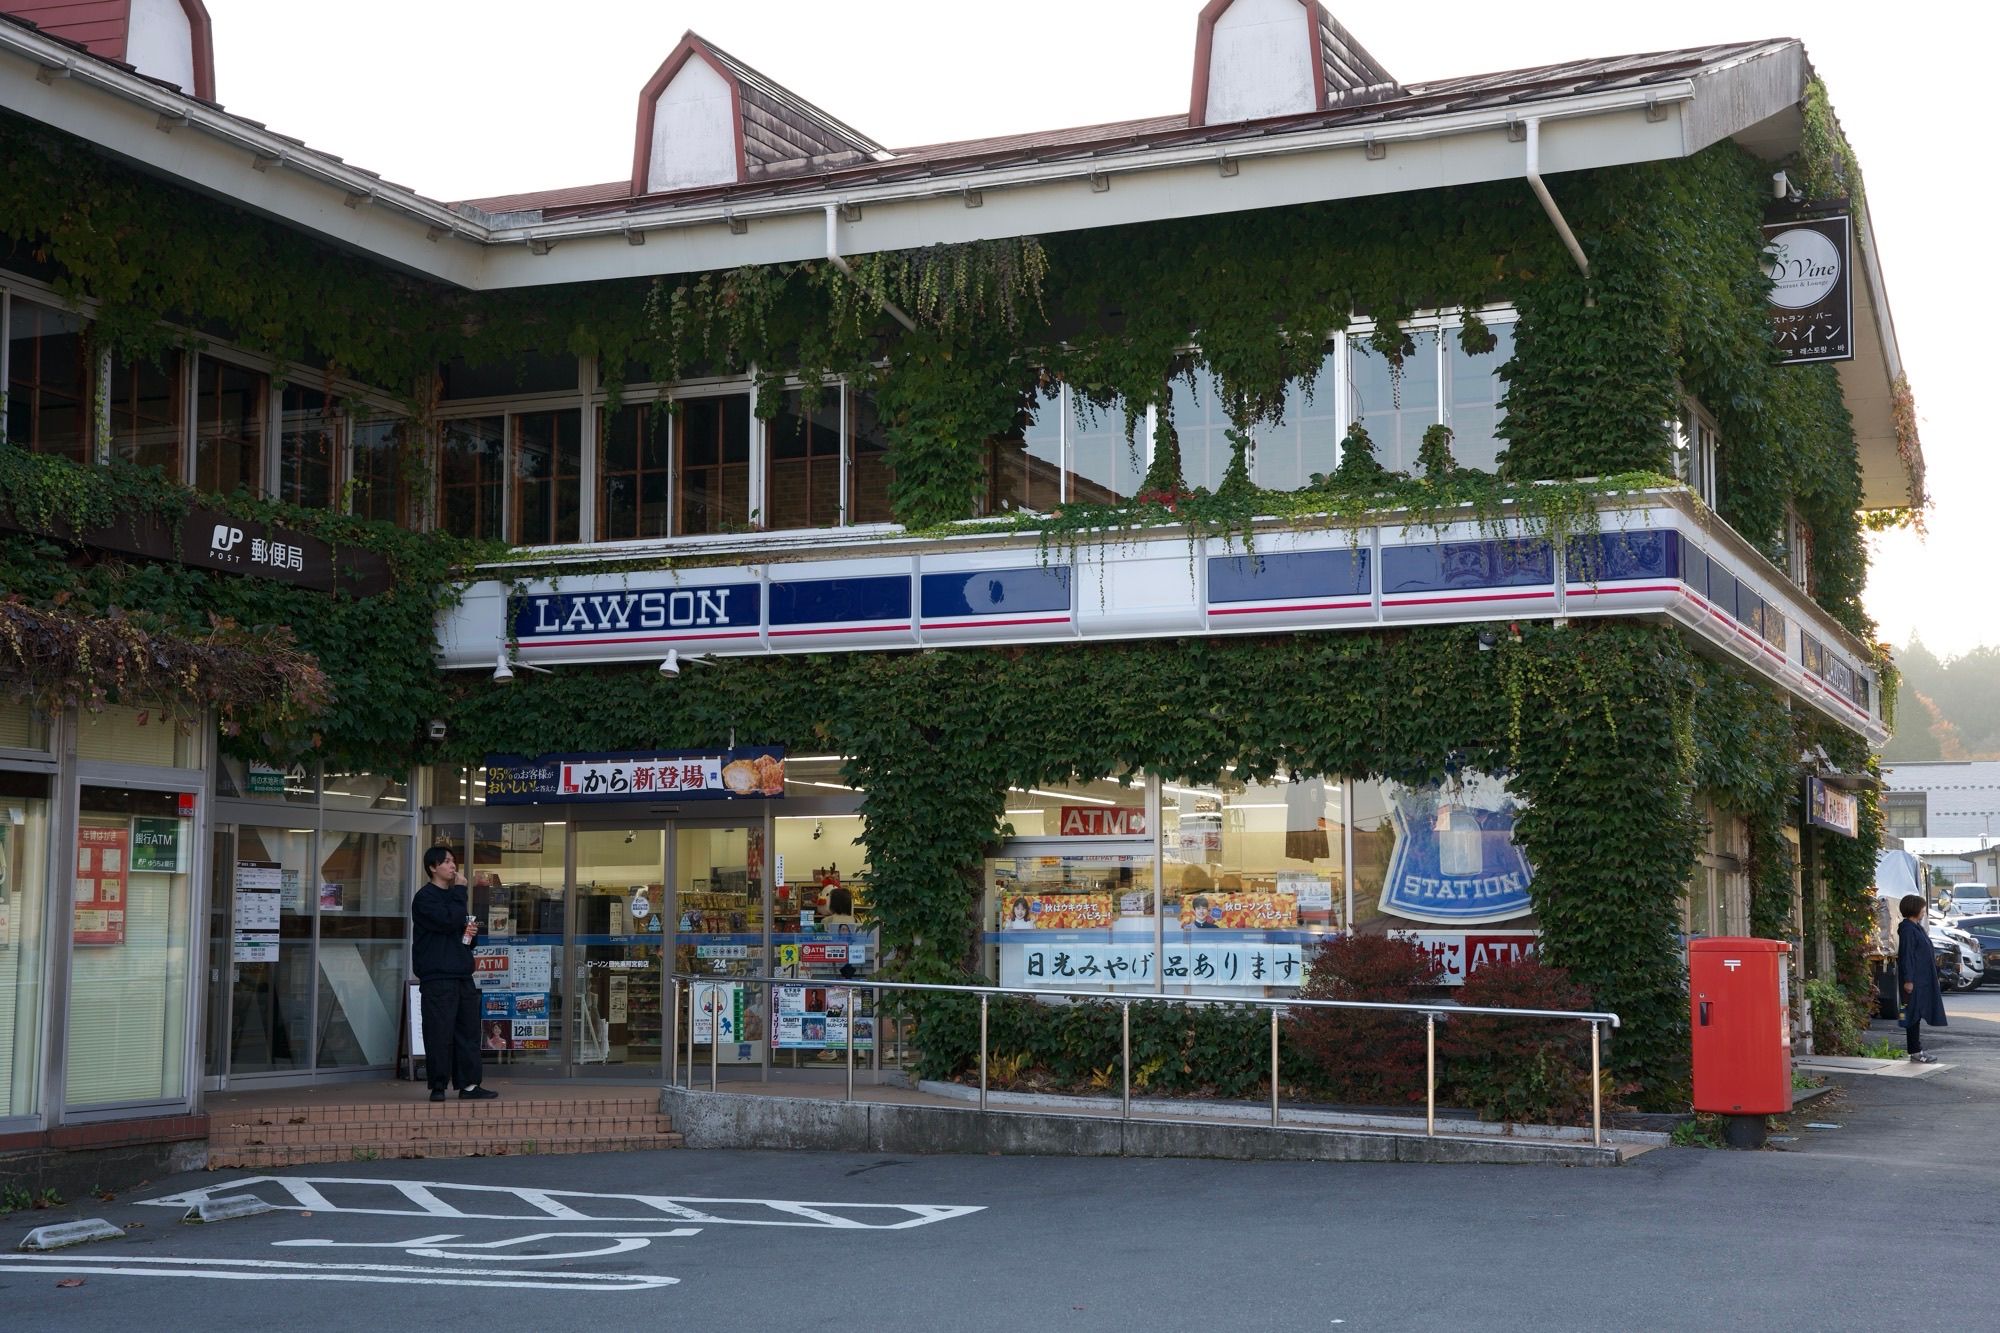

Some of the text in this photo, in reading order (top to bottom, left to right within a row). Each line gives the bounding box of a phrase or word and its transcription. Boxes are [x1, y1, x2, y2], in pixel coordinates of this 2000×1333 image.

[209, 550, 241, 563] POST
[251, 538, 303, 572] 郵便局
[535, 588, 730, 633] LAWSON
[1063, 809, 1128, 834] ATM
[135, 832, 172, 846] 銀行ATM
[1403, 872, 1523, 900] STATION
[1044, 903, 1098, 913] 秋はウキウキで
[1224, 902, 1272, 912] 秋ローソンで
[478, 959, 503, 969] ATM
